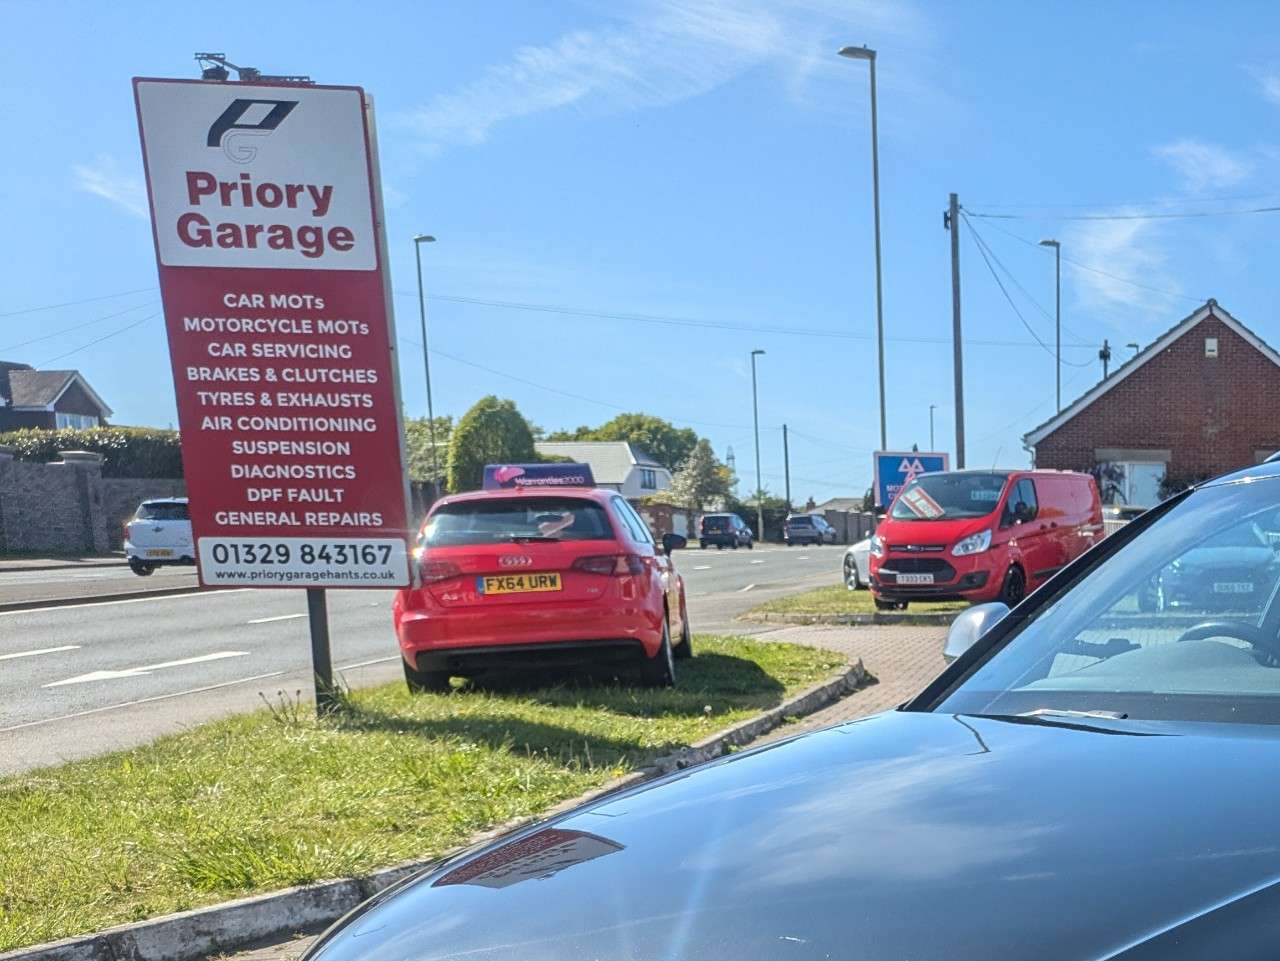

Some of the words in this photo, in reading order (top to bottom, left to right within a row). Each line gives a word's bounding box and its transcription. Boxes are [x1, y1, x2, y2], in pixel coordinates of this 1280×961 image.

[185, 170, 334, 217] Priory
[176, 212, 355, 258] Garage
[223, 293, 265, 308] CAR
[270, 294, 325, 309] MOTs
[183, 317, 313, 334] MOTORCYCLE
[318, 320, 369, 335] MOTs
[207, 342, 247, 357] CAR
[251, 343, 352, 359] SERVICING
[187, 367, 260, 382] BRAKES
[266, 368, 277, 382] &
[281, 368, 378, 384] CLUTCHES
[197, 391, 255, 406] TYRES
[260, 392, 272, 406] &
[277, 393, 373, 408] EXHAUSTS
[201, 416, 233, 431] AIR
[237, 417, 377, 432] CONDITIONING
[232, 441, 351, 456] SUSPENSION
[231, 464, 356, 480] DIAGNOSTICS
[247, 488, 283, 502] DPF
[287, 488, 345, 503] FAULT
[215, 511, 301, 526] GENERAL
[305, 512, 383, 527] REPAIRS
[212, 543, 291, 565] 01329
[300, 544, 393, 565] 843167
[215, 569, 395, 582] www.priorygaragehants.co.uk
[485, 576, 524, 592] FX64
[528, 574, 558, 589] URW
